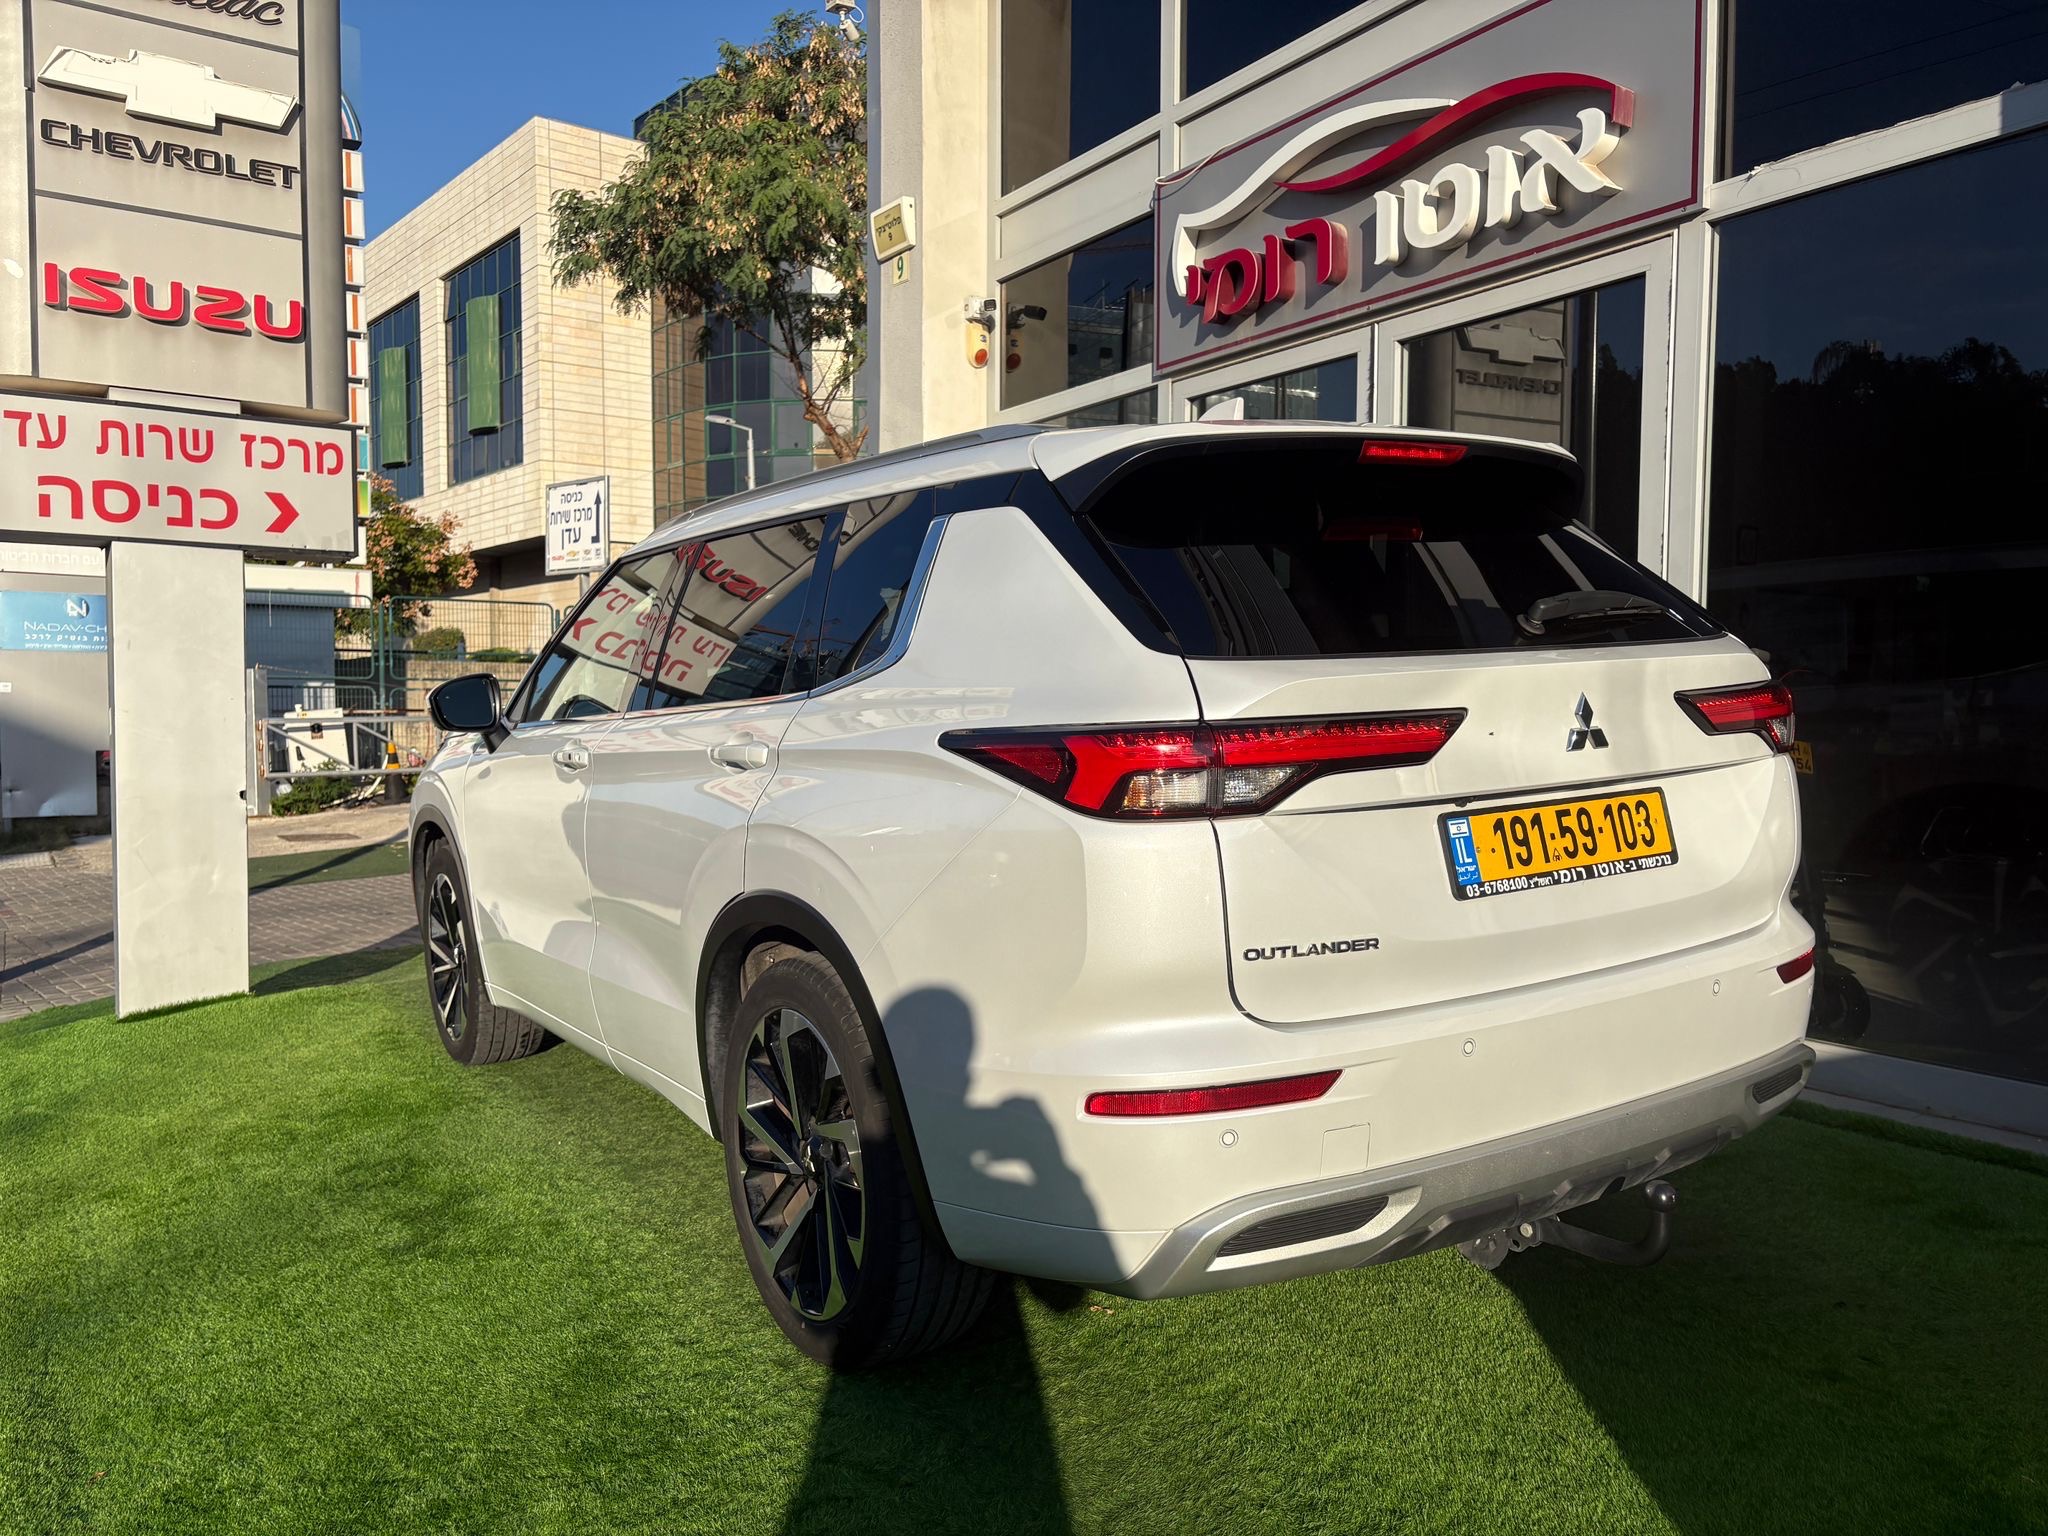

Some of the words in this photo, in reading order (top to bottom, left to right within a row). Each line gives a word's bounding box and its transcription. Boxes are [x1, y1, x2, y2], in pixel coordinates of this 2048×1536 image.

[40, 117, 301, 190] CHEVROLET
[1373, 107, 1623, 266] אוטו
[897, 256, 903, 279] 9
[1186, 217, 1348, 325] רומי
[43, 261, 306, 344] ISUZU
[96, 419, 214, 463] שרות
[239, 432, 344, 476] מרכז
[37, 474, 239, 530] כניסה
[561, 492, 582, 504] כניסה
[550, 510, 571, 525] שירות
[574, 507, 592, 522] מרכז
[562, 527, 581, 550] עדן
[1455, 837, 1473, 864] IL
[1466, 876, 1528, 897] 03-6768100
[1243, 938, 1379, 961] OUTLANDER
